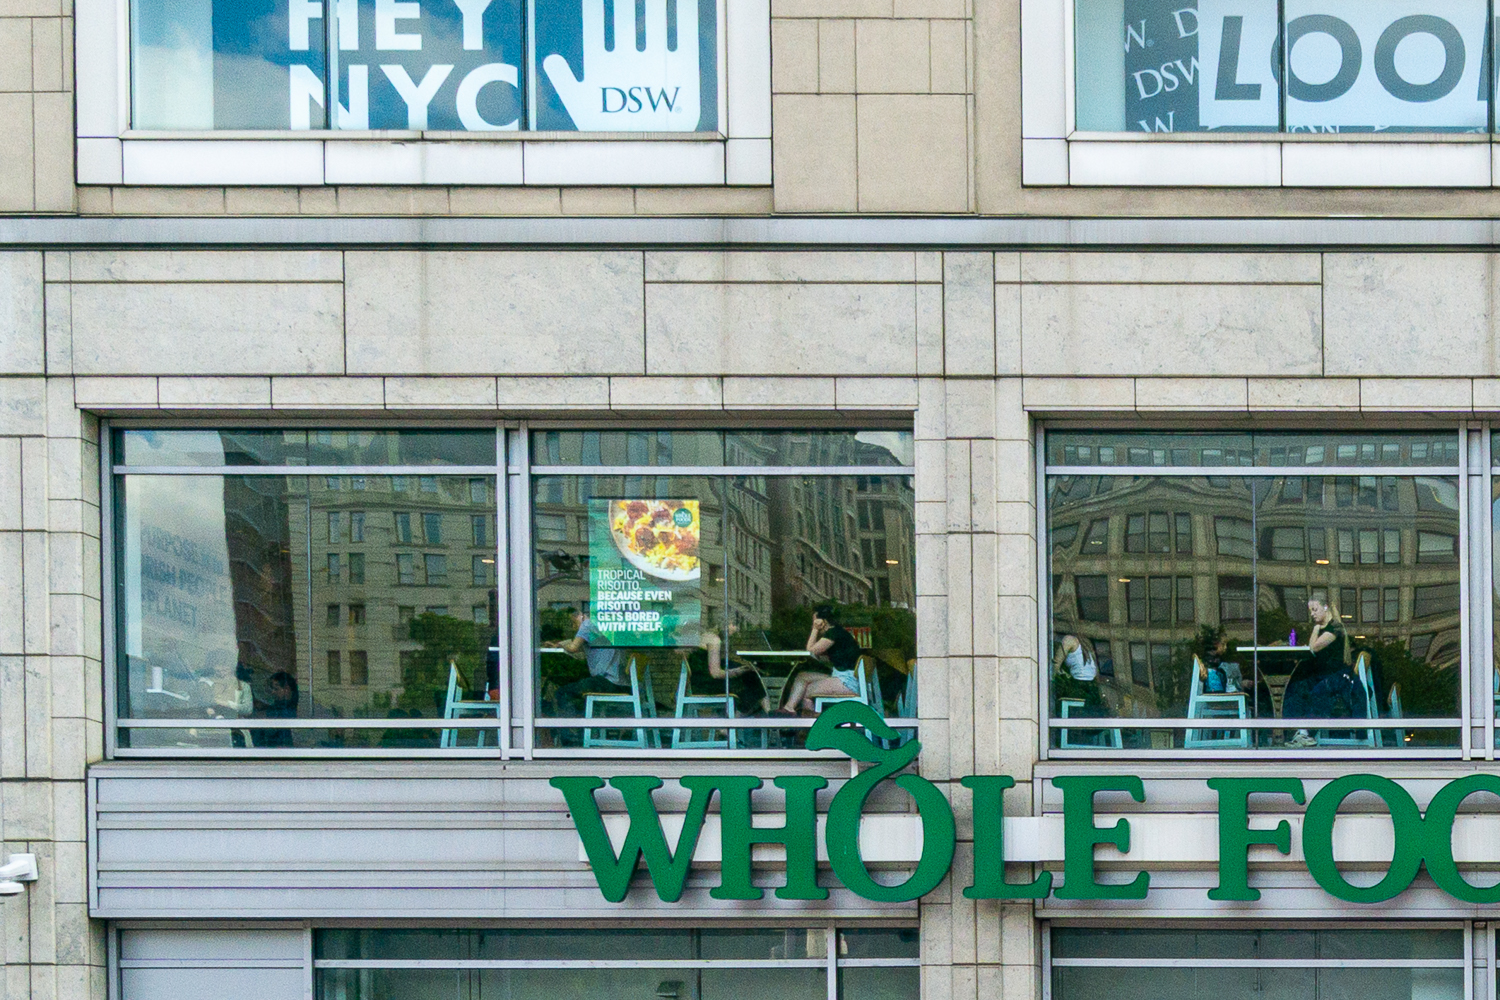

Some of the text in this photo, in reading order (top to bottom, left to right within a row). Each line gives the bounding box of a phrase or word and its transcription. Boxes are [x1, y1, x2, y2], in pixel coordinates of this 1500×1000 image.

[289, 0, 493, 50] HEY
[289, 63, 519, 130] NYC
[600, 85, 681, 115] DSW
[597, 570, 646, 580] TROPICAL
[597, 580, 642, 591] RISOTTO.
[597, 591, 672, 601] BECAUSE EVEN
[597, 601, 641, 611] RISOTTO
[597, 611, 660, 622] GETS BORED
[598, 622, 664, 632] WITH ITSELF.
[549, 701, 1151, 904] WHOLE
